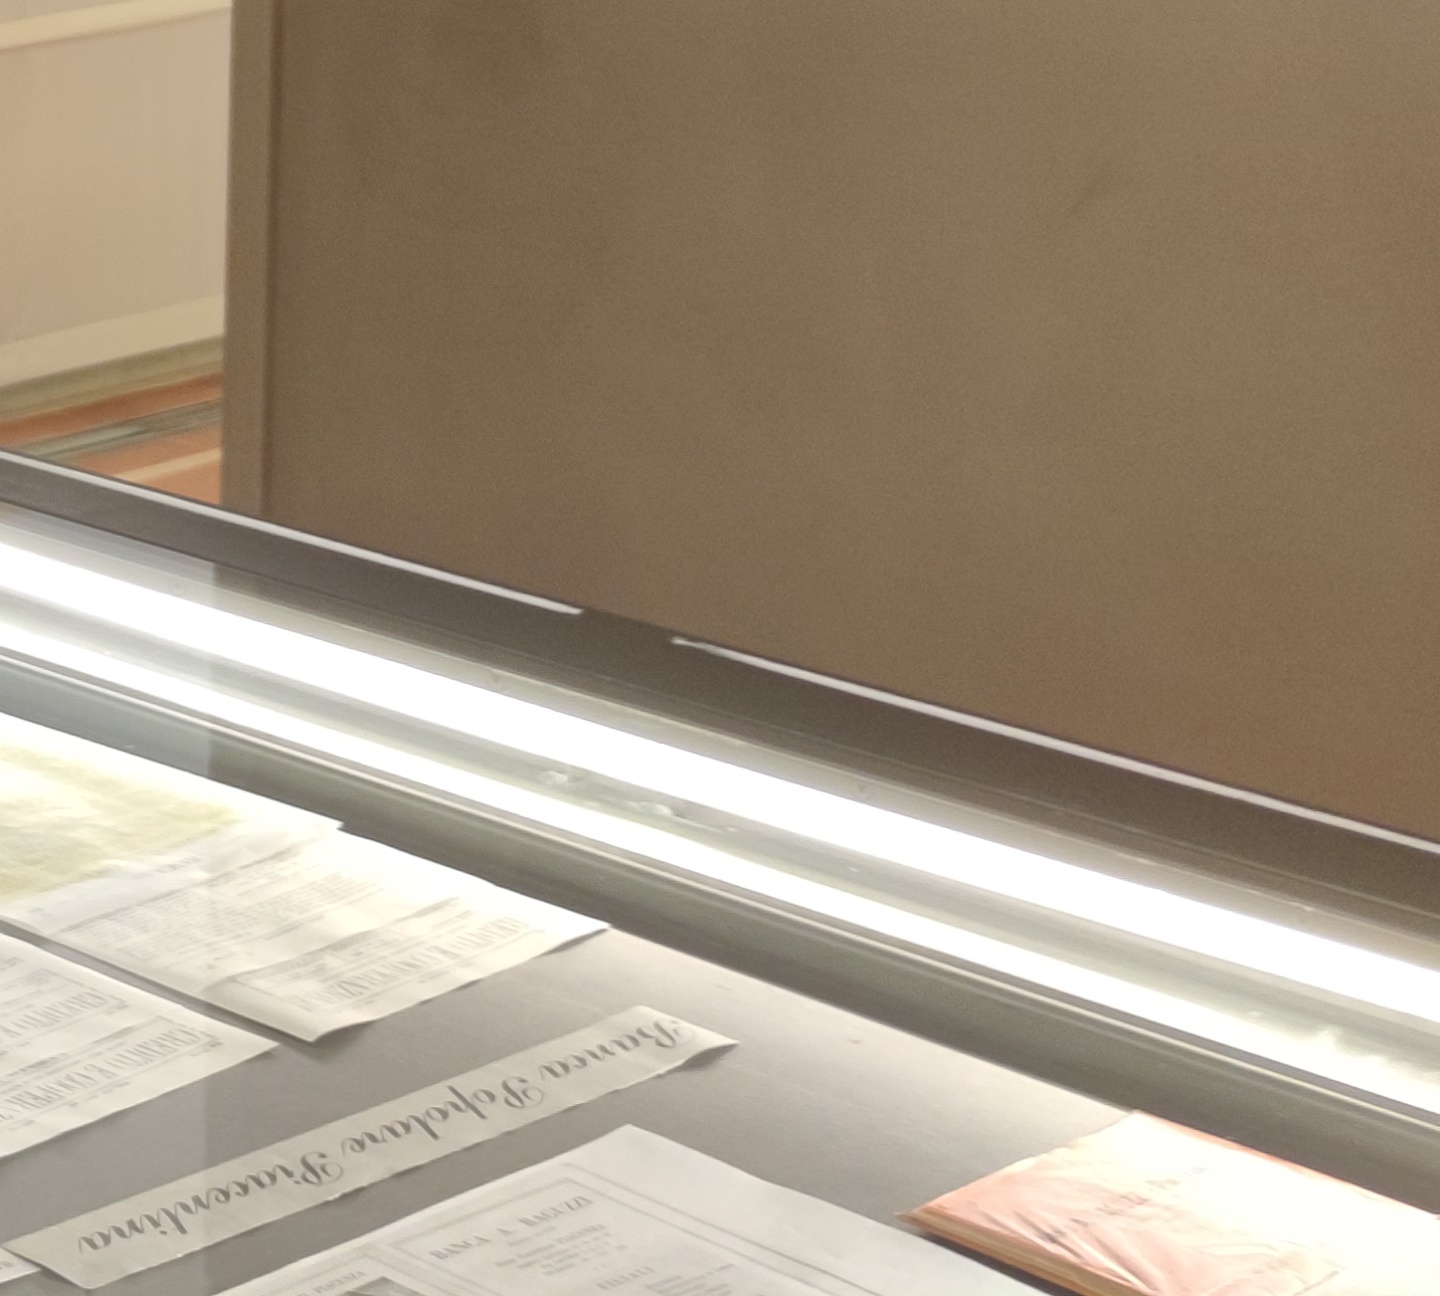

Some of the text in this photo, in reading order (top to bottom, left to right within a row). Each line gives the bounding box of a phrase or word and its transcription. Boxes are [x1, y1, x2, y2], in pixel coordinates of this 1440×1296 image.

[78, 1019, 695, 1253] Banca Popolare Piacentina
